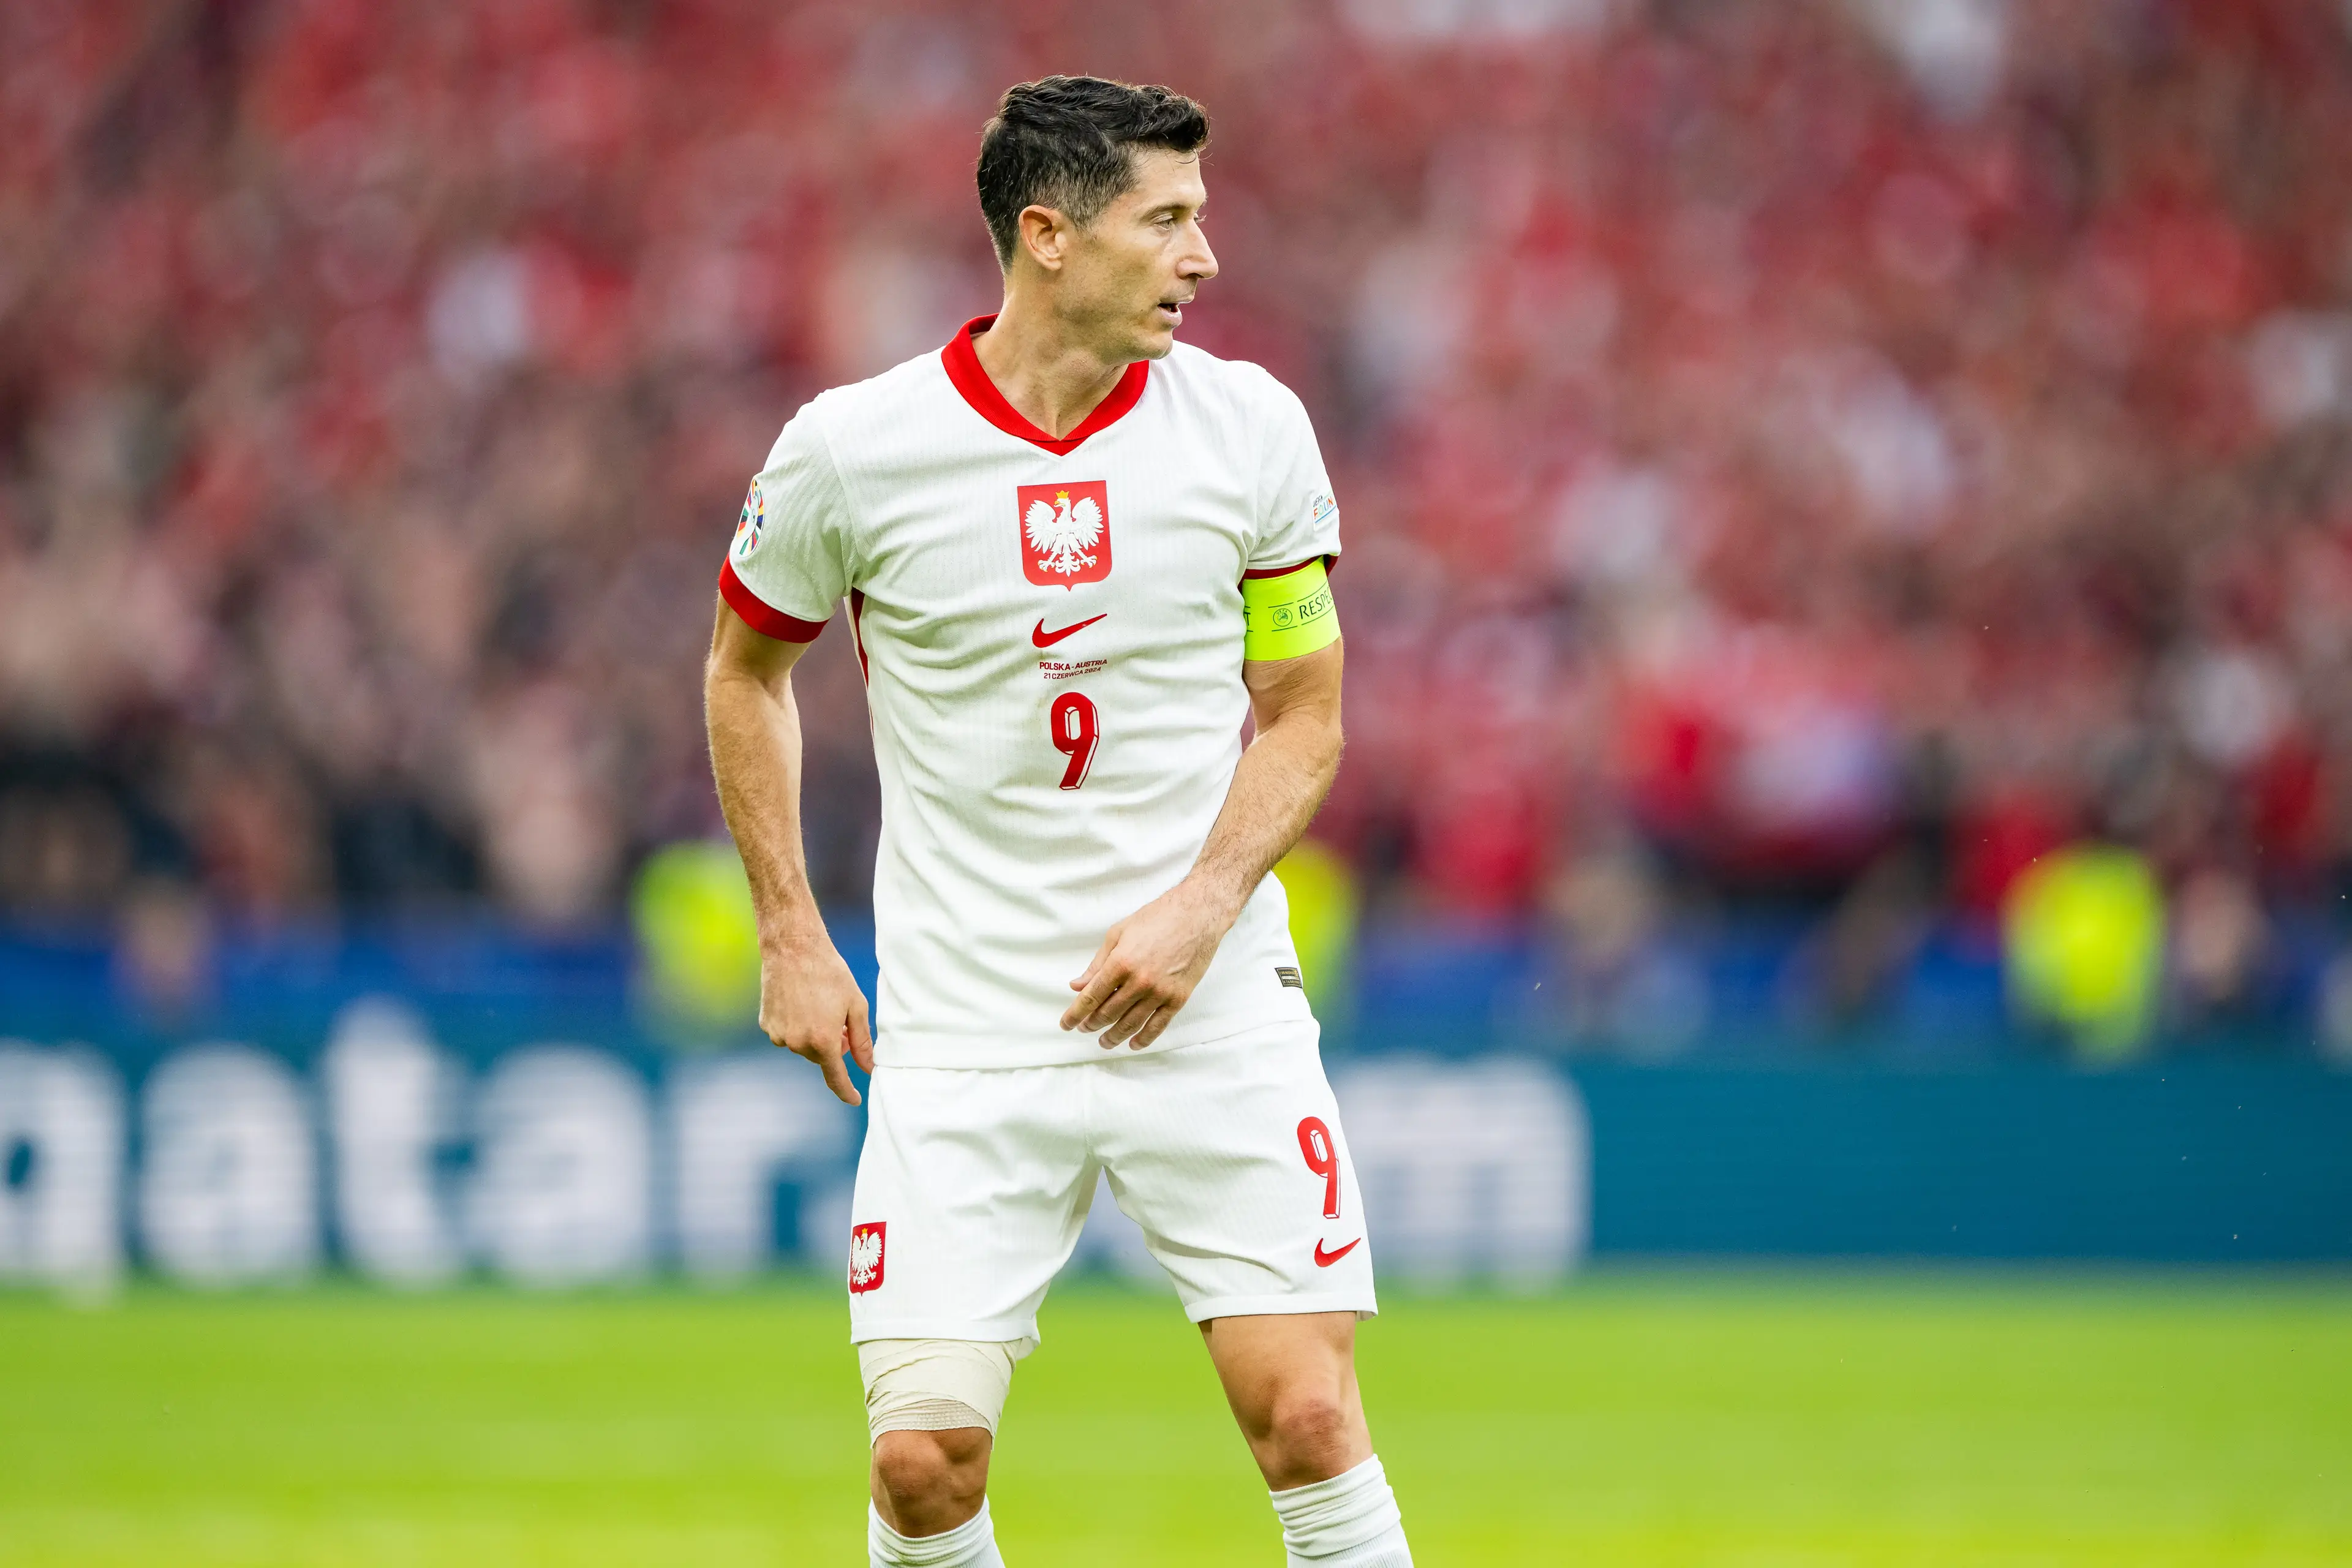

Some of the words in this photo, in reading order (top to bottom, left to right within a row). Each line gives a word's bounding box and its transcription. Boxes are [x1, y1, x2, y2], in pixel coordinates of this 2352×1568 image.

[1313, 497, 1334, 519] FOUN
[1299, 586, 1333, 620] RESPEC
[1039, 662, 1071, 671] POLSKA
[1075, 659, 1107, 669] AUSTRIA
[1052, 670, 1084, 679] CZERWCA
[1050, 692, 1099, 790] 9
[1297, 1116, 1341, 1219] 9
